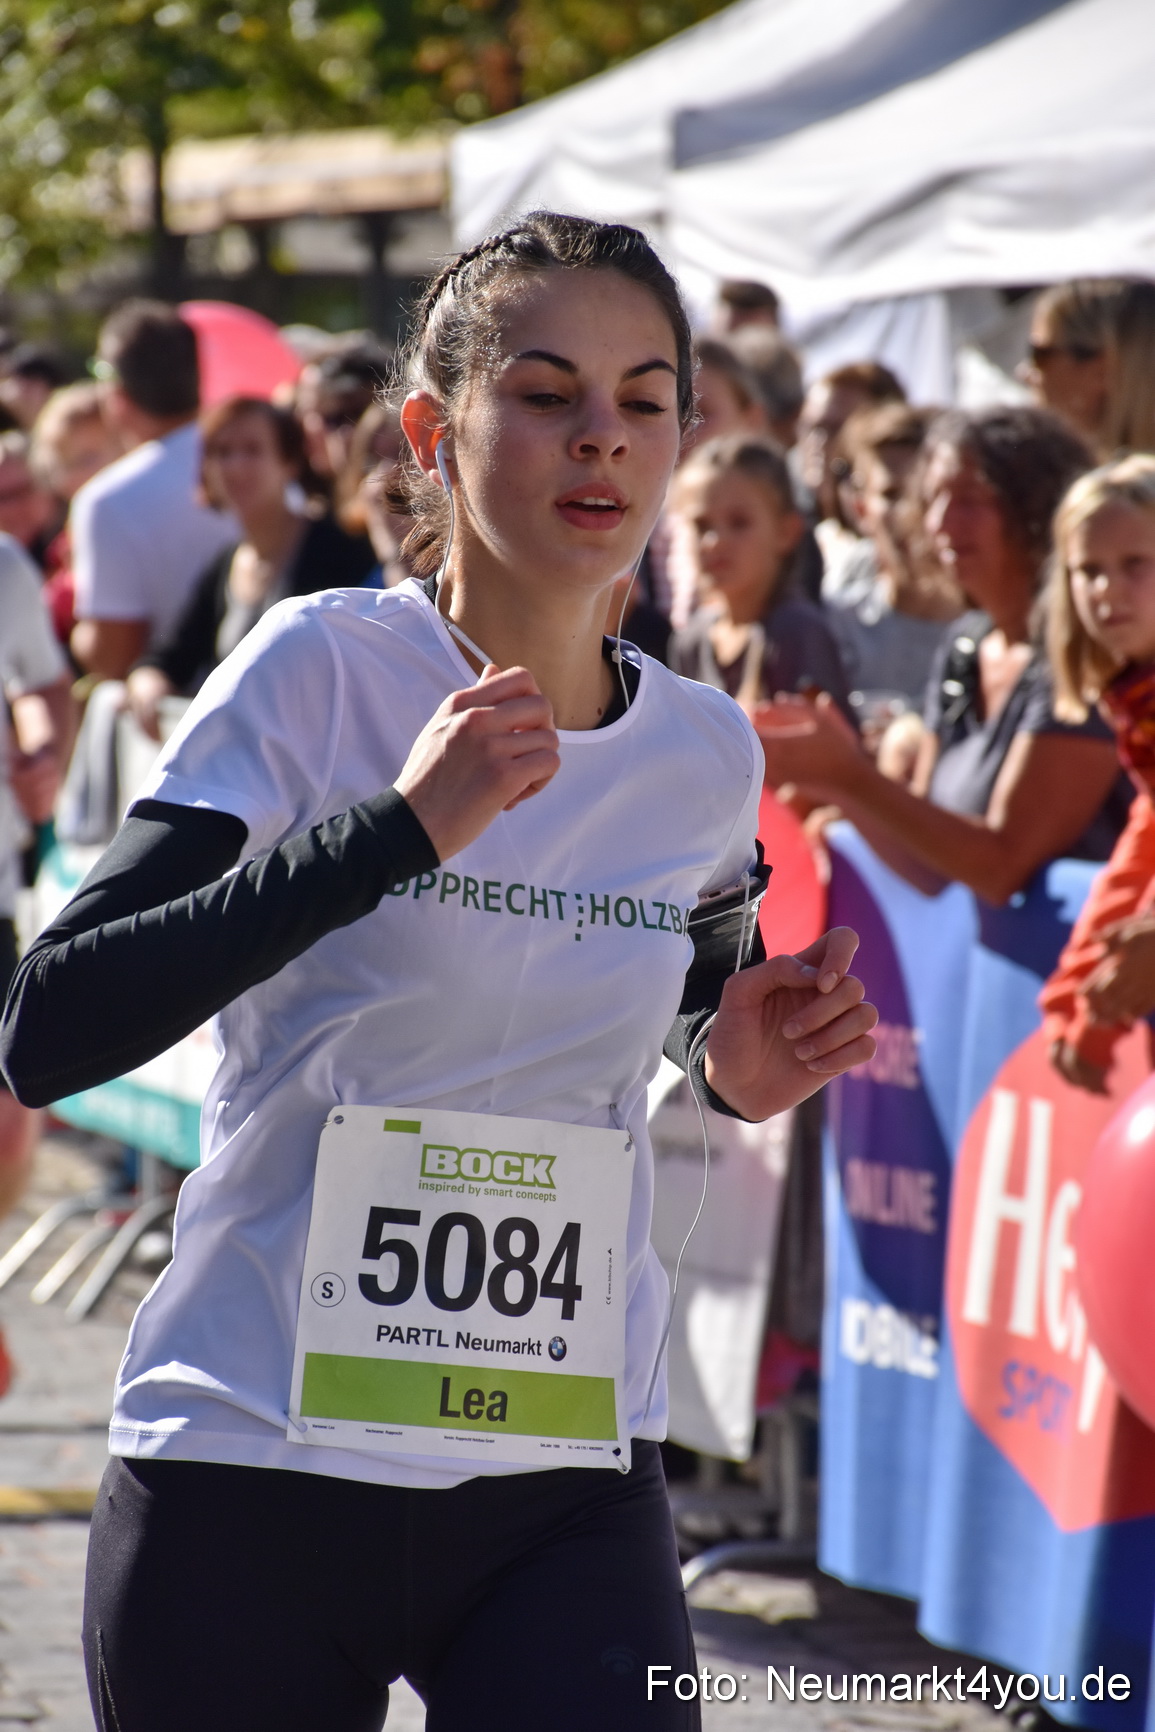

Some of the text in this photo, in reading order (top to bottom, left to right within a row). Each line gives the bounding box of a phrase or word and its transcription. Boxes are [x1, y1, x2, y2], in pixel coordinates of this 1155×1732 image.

[420, 1144, 557, 1190] BOCK
[418, 1179, 557, 1204] inspired by smart concepts
[358, 1206, 582, 1321] 5084
[320, 1280, 334, 1299] S
[376, 1324, 542, 1356] PARTL Neumarkt
[439, 1376, 508, 1422] Lea
